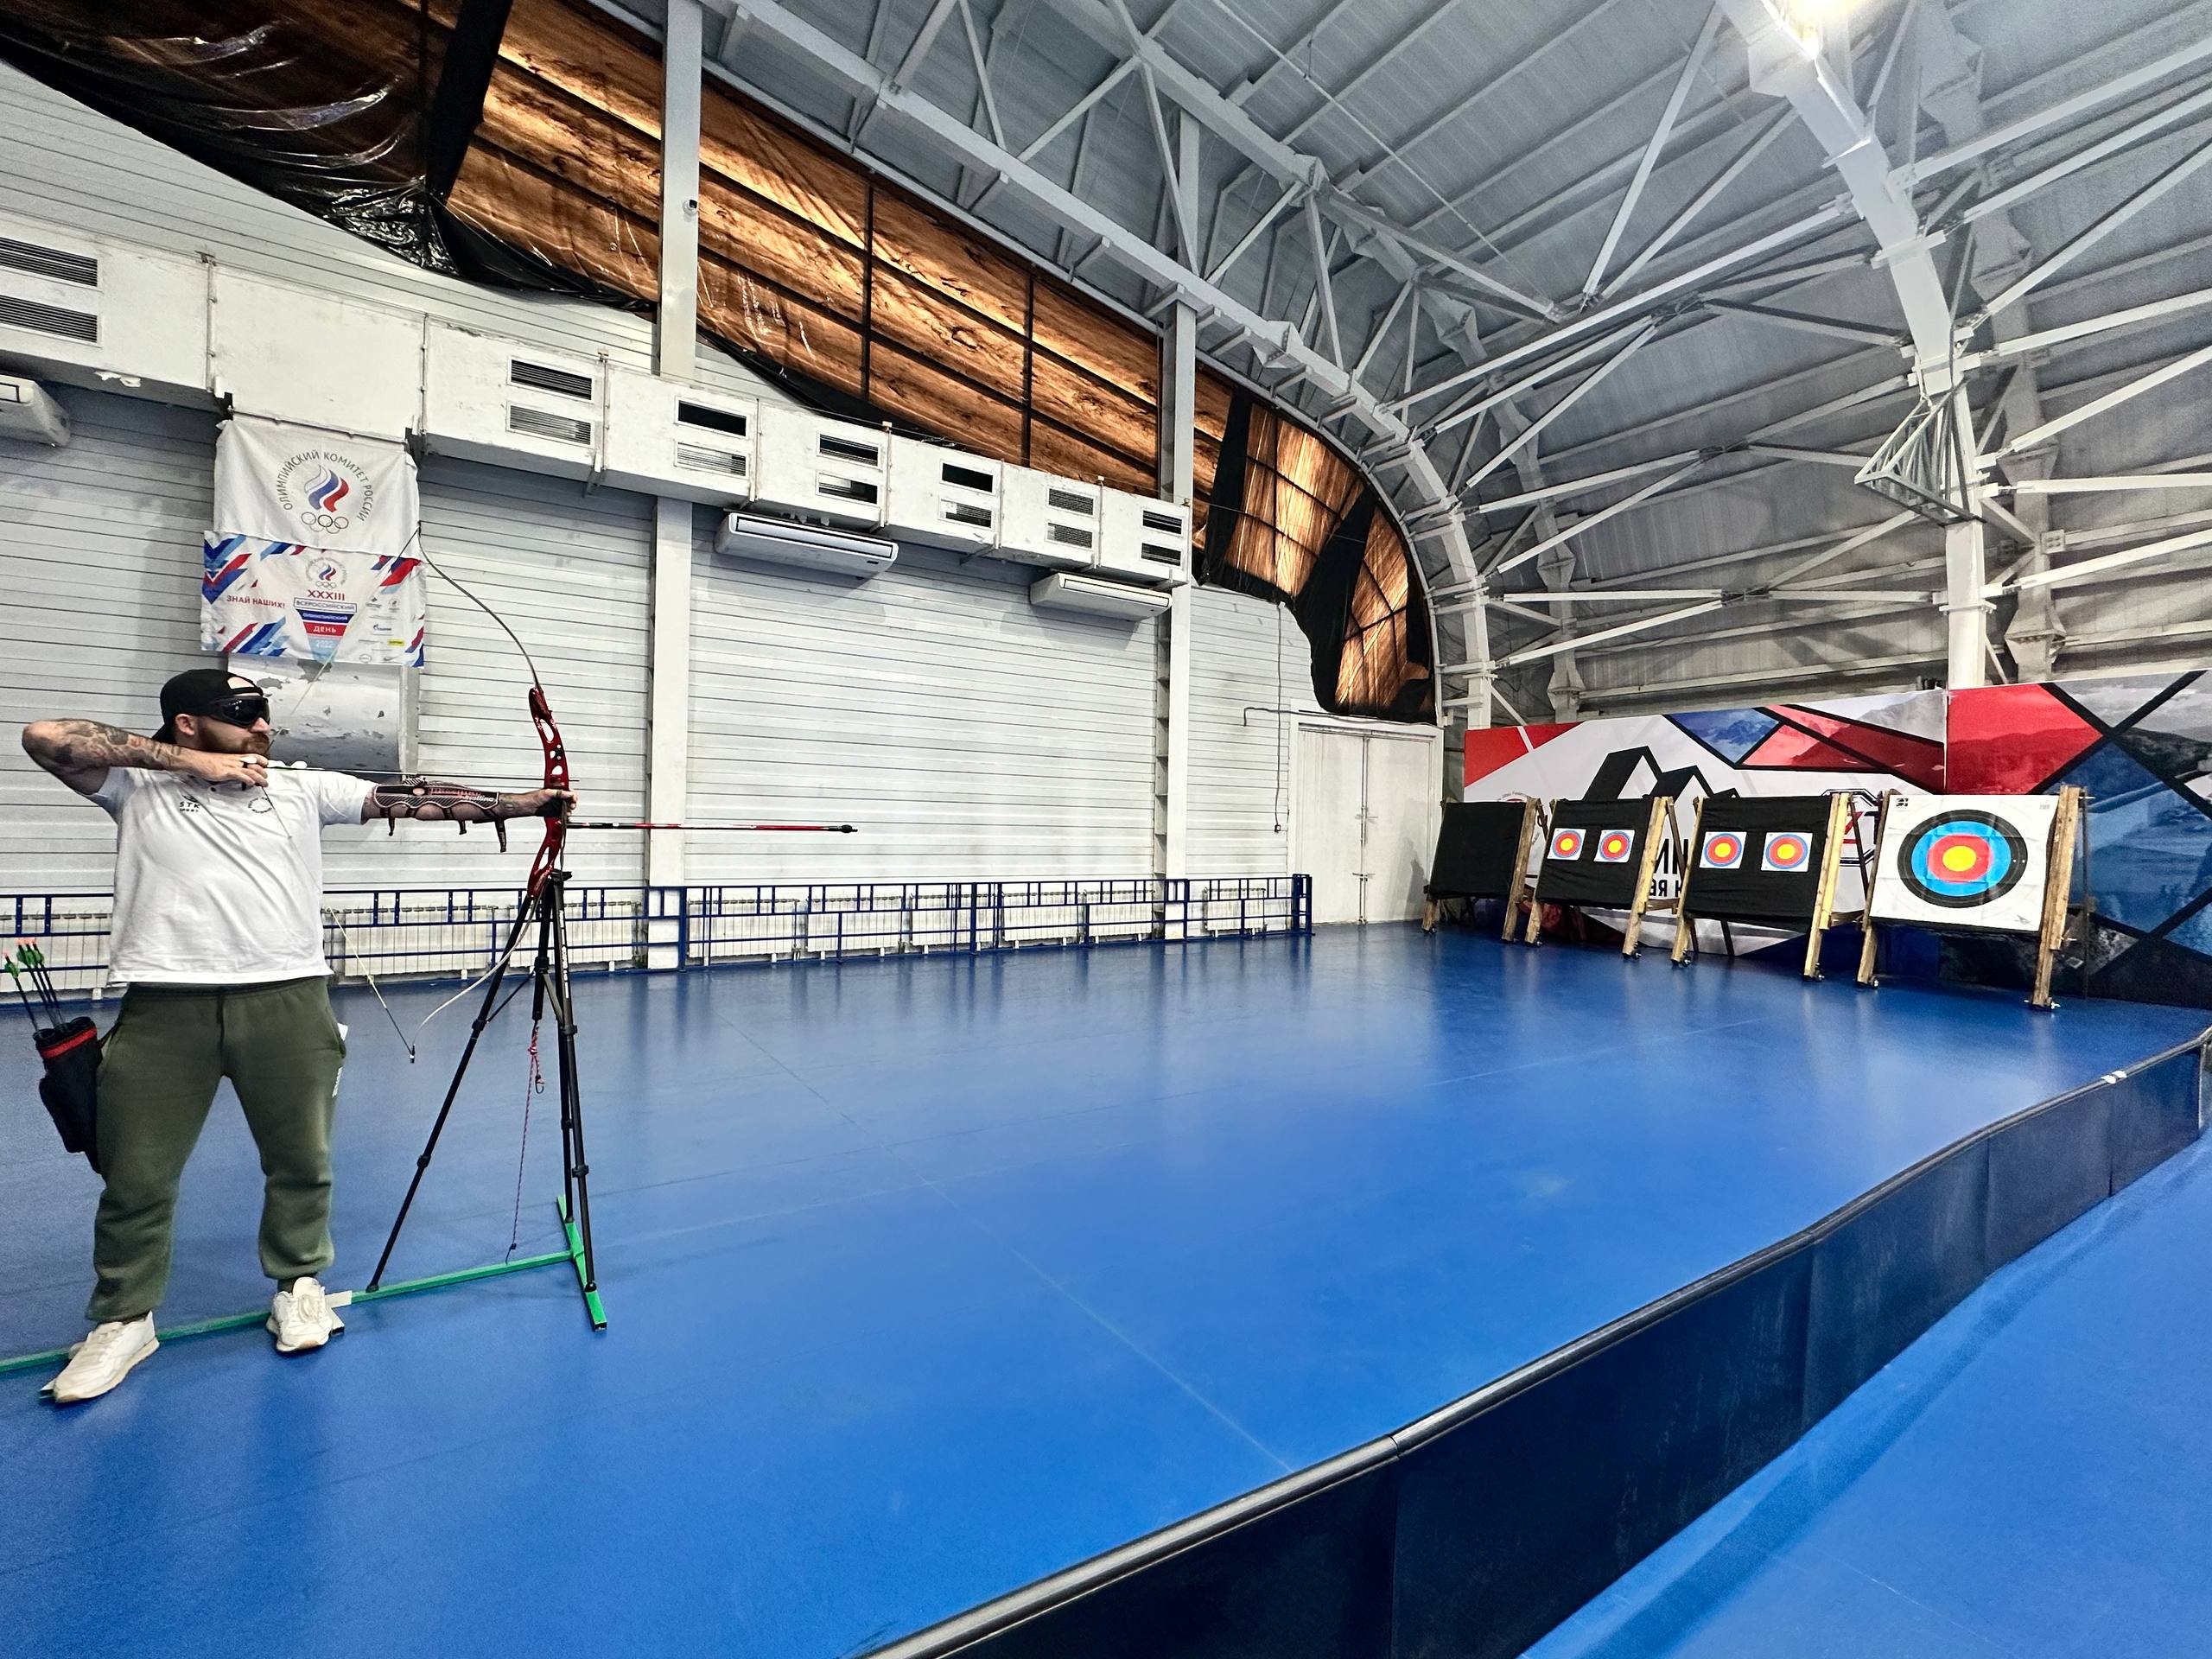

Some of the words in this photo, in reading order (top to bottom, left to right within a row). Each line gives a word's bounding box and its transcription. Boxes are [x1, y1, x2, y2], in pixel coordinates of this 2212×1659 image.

[276, 449, 320, 511] ОЛИМПИЙСКИЙ
[323, 451, 369, 482] КОМИТЕТ
[357, 484, 374, 522] РОССИИ
[226, 594, 251, 604] ЗНАЙ
[252, 597, 285, 608] НАШИХ!
[308, 589, 346, 601] XXXIII
[296, 600, 355, 611] ВСЕРОССИЙСКИЙ
